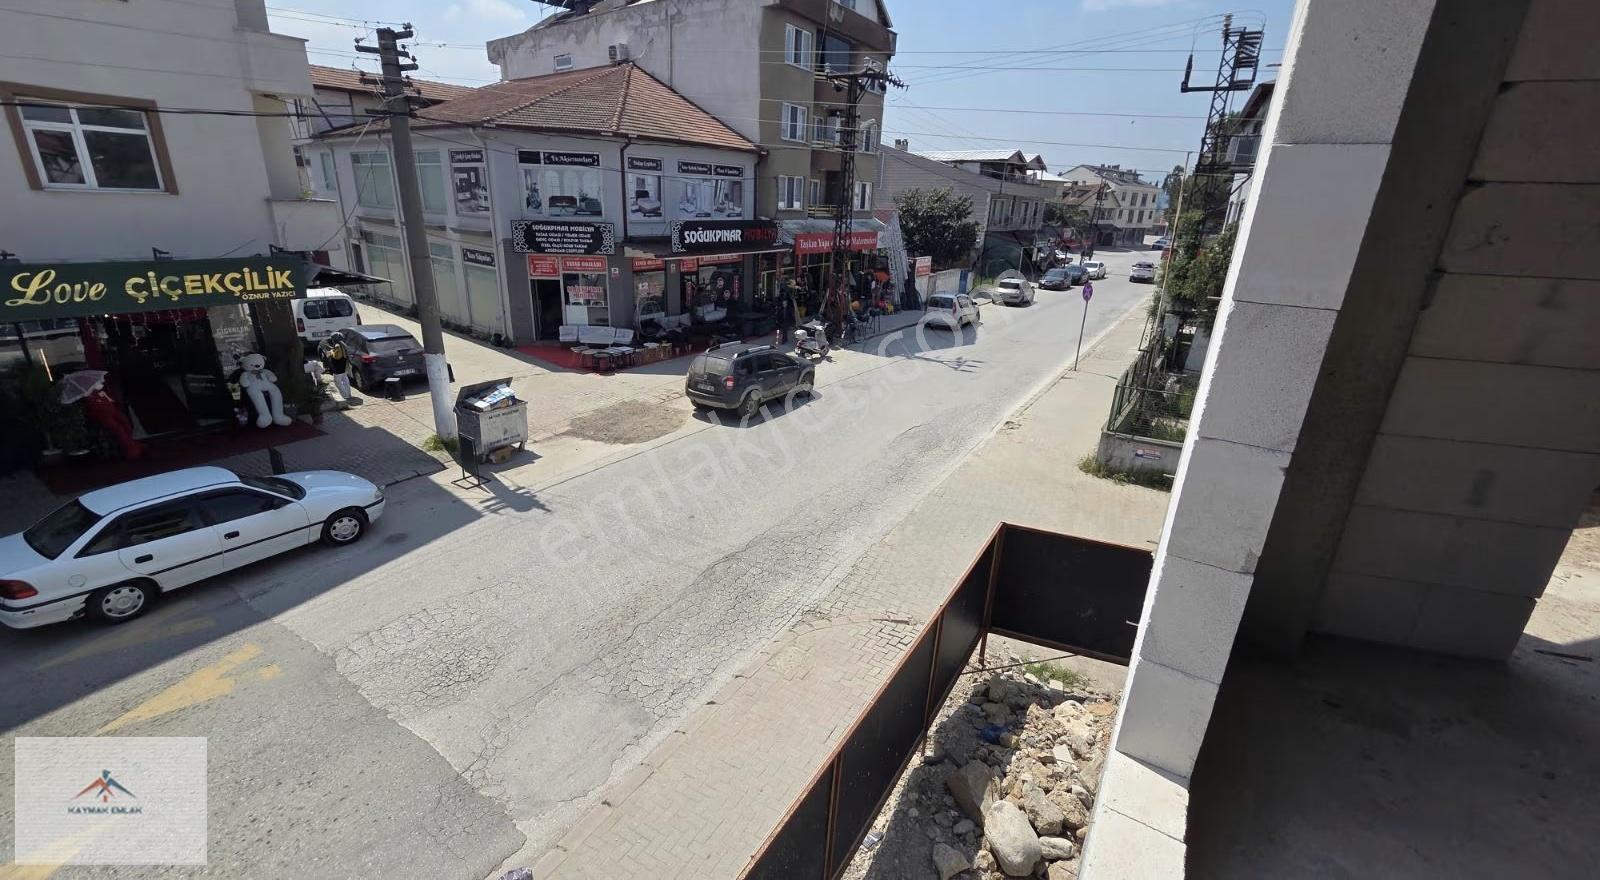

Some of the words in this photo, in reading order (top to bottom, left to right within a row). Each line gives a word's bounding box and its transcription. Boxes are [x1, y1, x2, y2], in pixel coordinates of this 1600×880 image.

[532, 224, 569, 232] SOĞUKPINAR
[569, 225, 595, 233] MOBİLYA
[684, 227, 742, 244] SOĞUKPINAR
[743, 226, 777, 242] MOBİLYA
[5, 269, 107, 307] Love
[124, 265, 295, 304] ÇİÇEKÇİLİK
[242, 291, 270, 300] ÖZNUR
[271, 290, 296, 298] YAZICI
